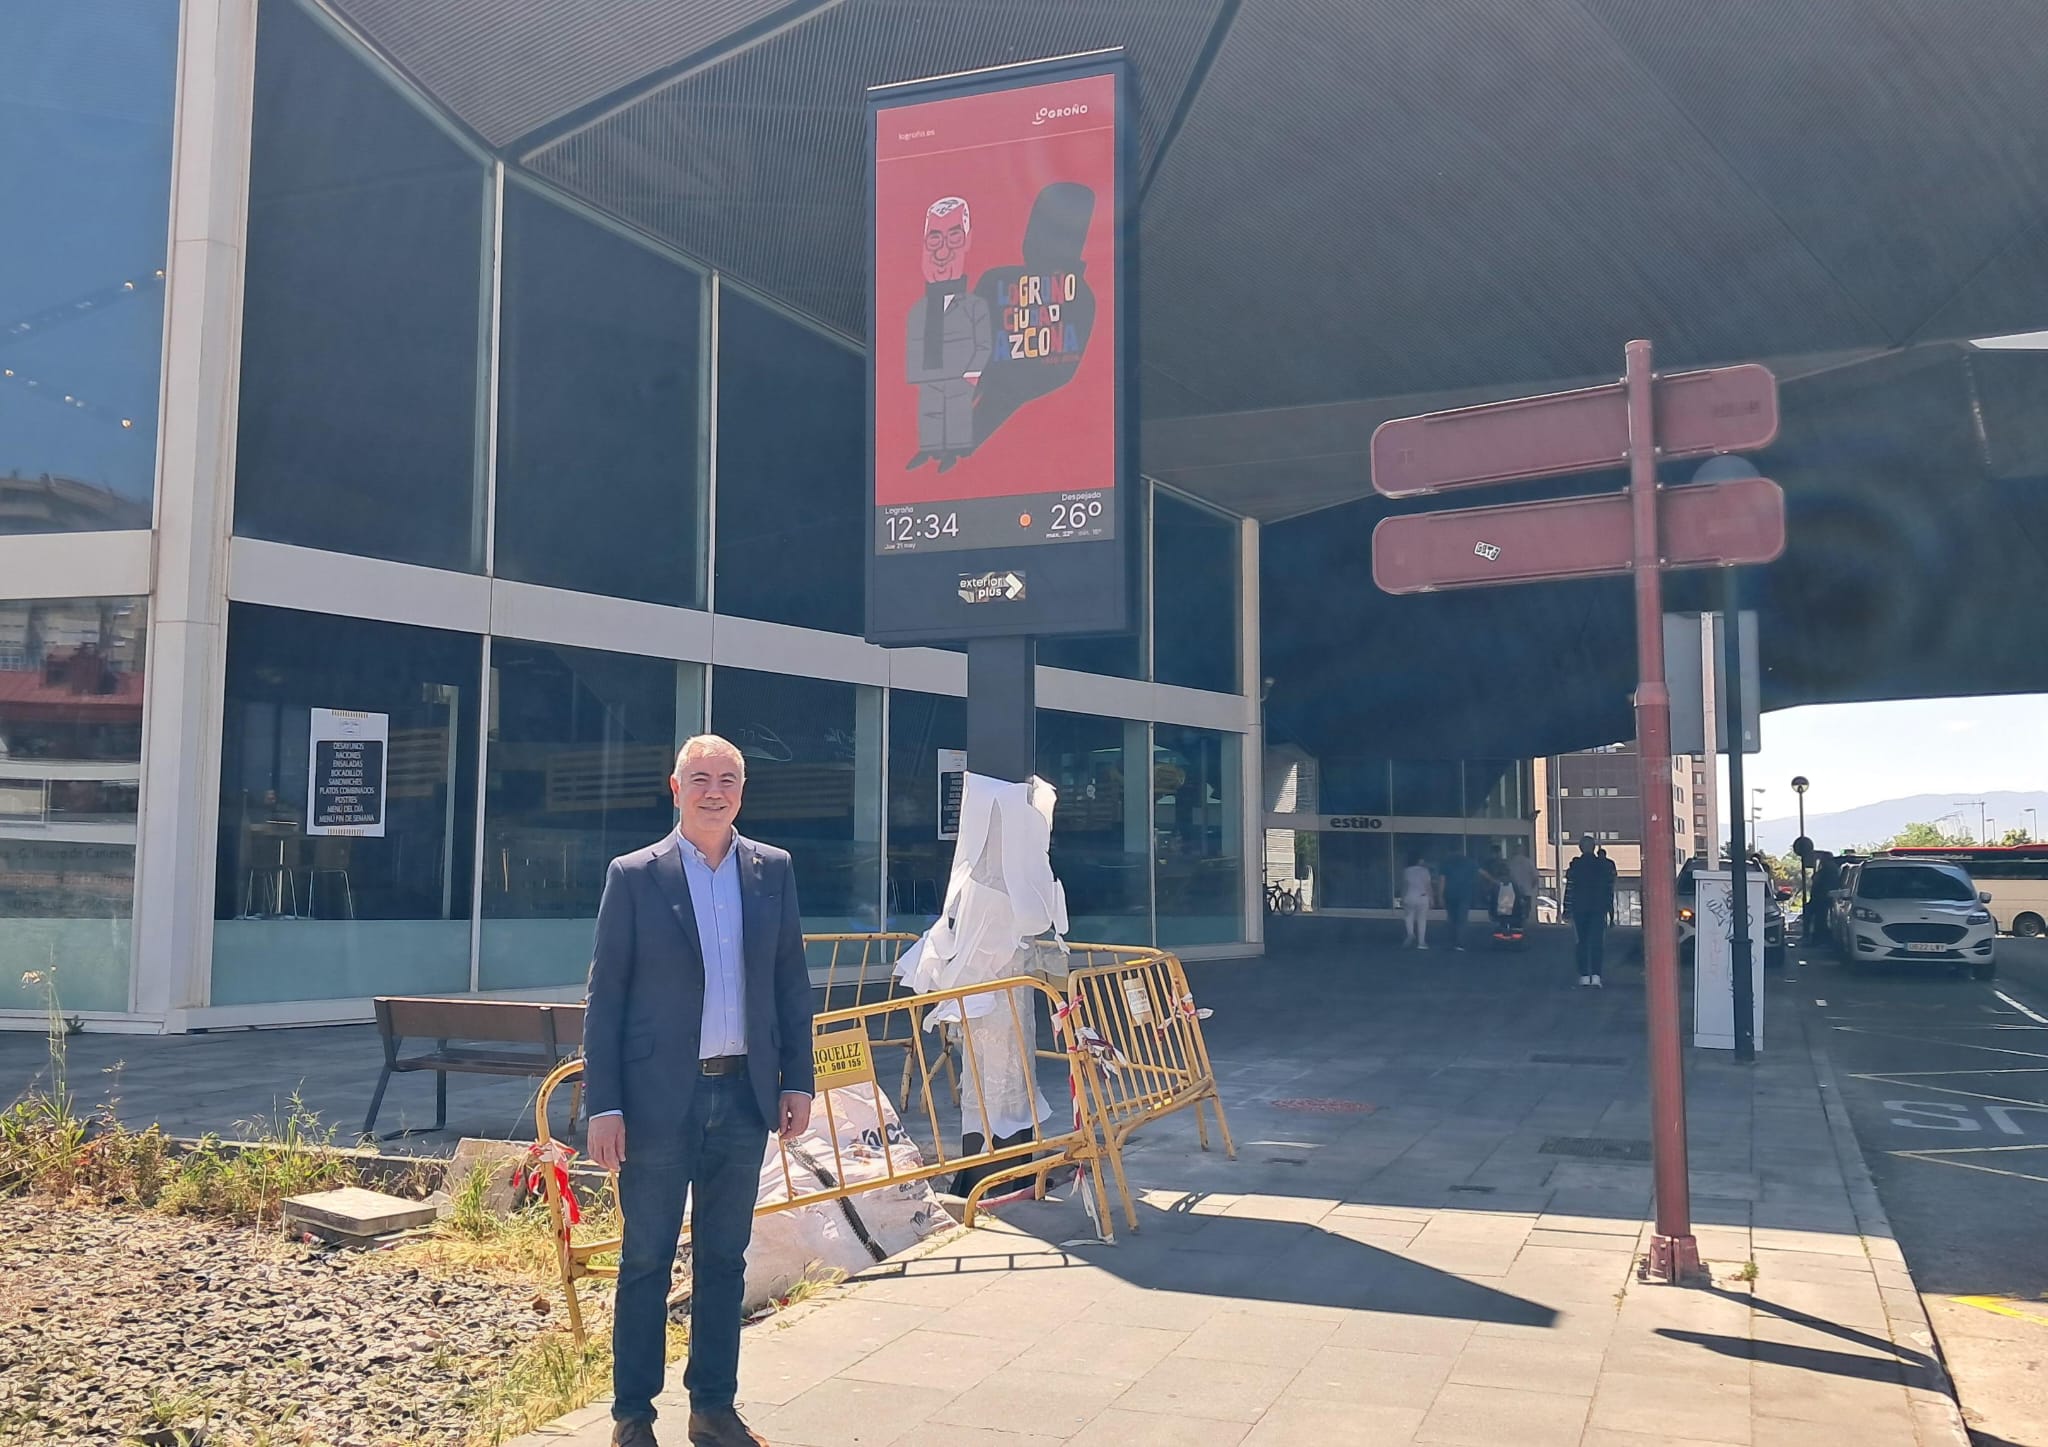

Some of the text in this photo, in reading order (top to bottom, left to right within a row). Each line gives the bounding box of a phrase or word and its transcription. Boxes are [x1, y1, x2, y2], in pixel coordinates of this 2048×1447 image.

[1035, 104, 1088, 121] LOGROÑO
[1061, 491, 1102, 502] Despejado
[885, 512, 960, 542] 12:34
[960, 577, 1003, 588] exterior
[978, 587, 1002, 600] plus
[333, 742, 364, 750] DESAYUNOS
[330, 769, 363, 777] BOCADILLOS
[353, 814, 374, 822] SEMANA
[1330, 816, 1383, 829] estilo
[831, 1060, 846, 1071] 500
[848, 1058, 862, 1069] 155
